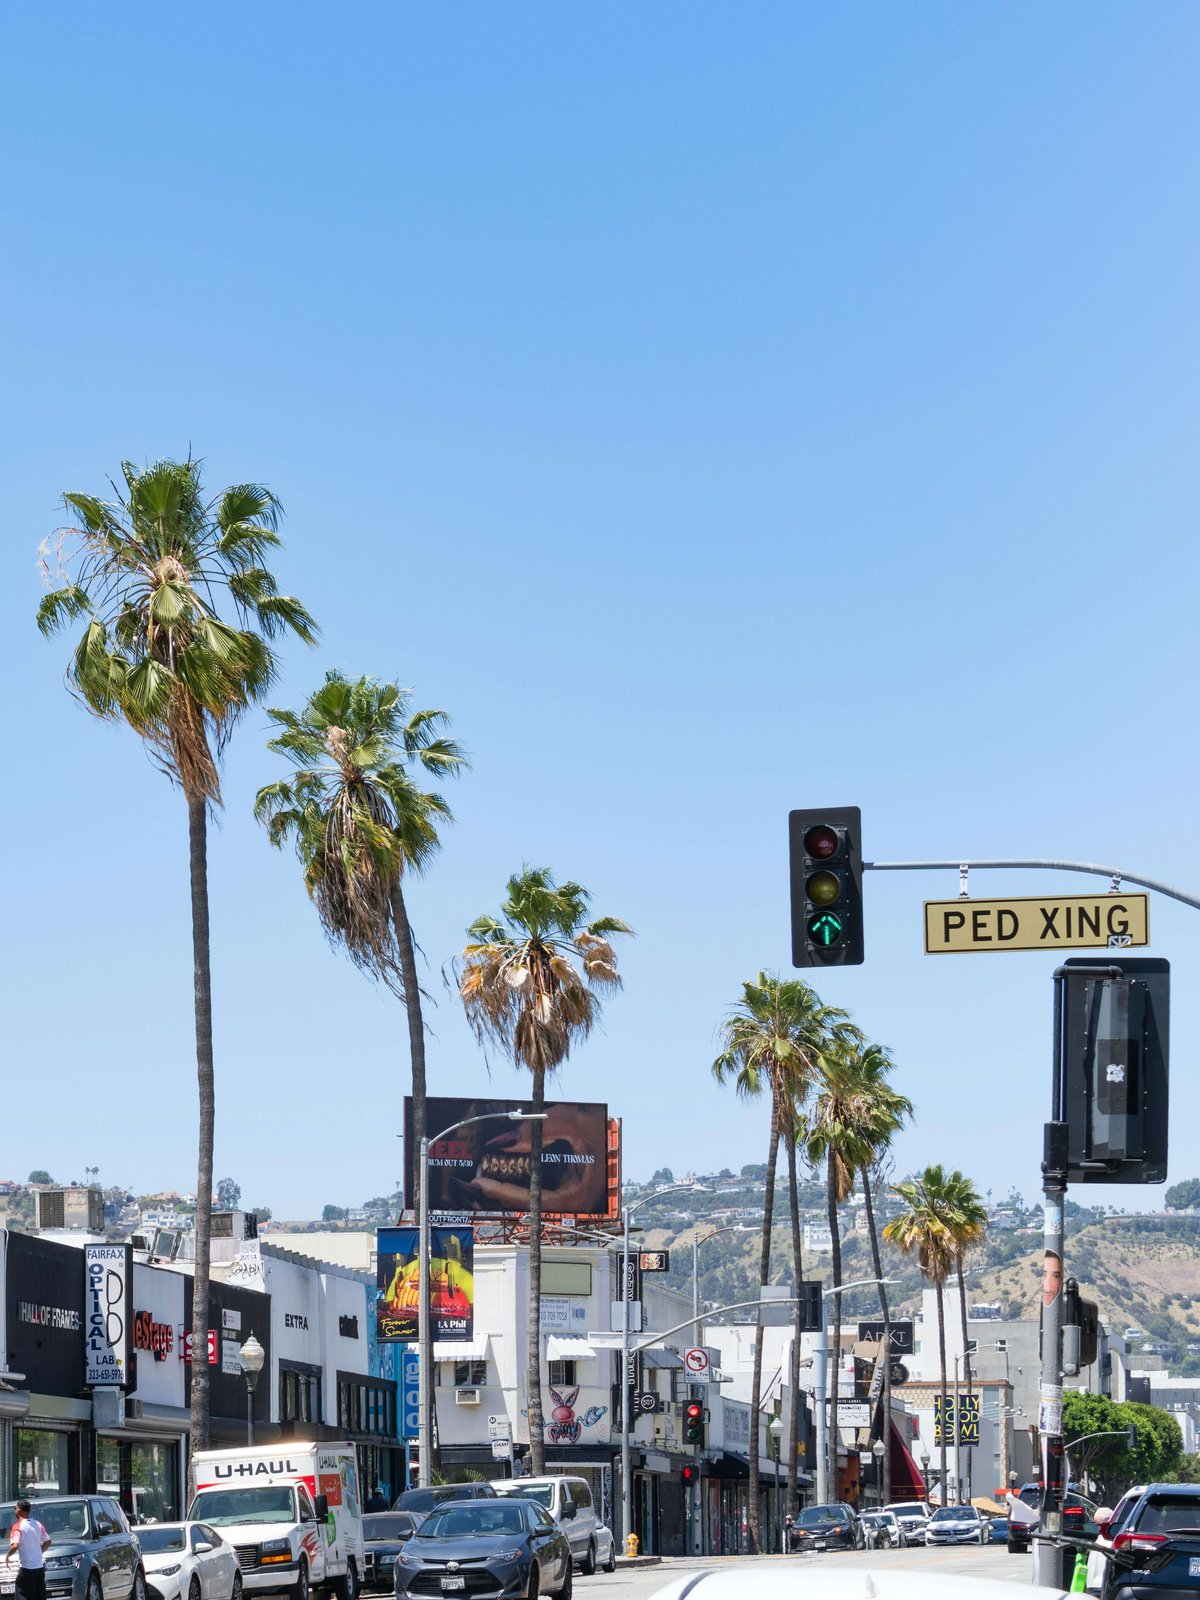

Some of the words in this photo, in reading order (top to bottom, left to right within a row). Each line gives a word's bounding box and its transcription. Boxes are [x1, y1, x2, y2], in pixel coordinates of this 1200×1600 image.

[944, 910, 1019, 942] PED
[1039, 905, 1129, 939] XING
[444, 1159, 458, 1167] OUT
[459, 1159, 473, 1168] 5/30
[541, 1153, 561, 1163] LEON
[562, 1154, 595, 1164] THOMAS
[87, 1250, 124, 1260] FAIRFAX
[88, 1264, 105, 1350] OPTICAL
[21, 1302, 39, 1323] HALL
[40, 1306, 51, 1326] OF
[52, 1308, 80, 1331] FRAMES
[285, 1313, 309, 1330] EXTRA
[381, 1318, 411, 1330] Forever
[385, 1326, 416, 1337] Summer
[96, 1355, 115, 1365] LAB
[88, 1370, 124, 1380] 323-651-5976
[318, 1456, 337, 1469] U-HAUL
[215, 1460, 298, 1478] U-HAUL
